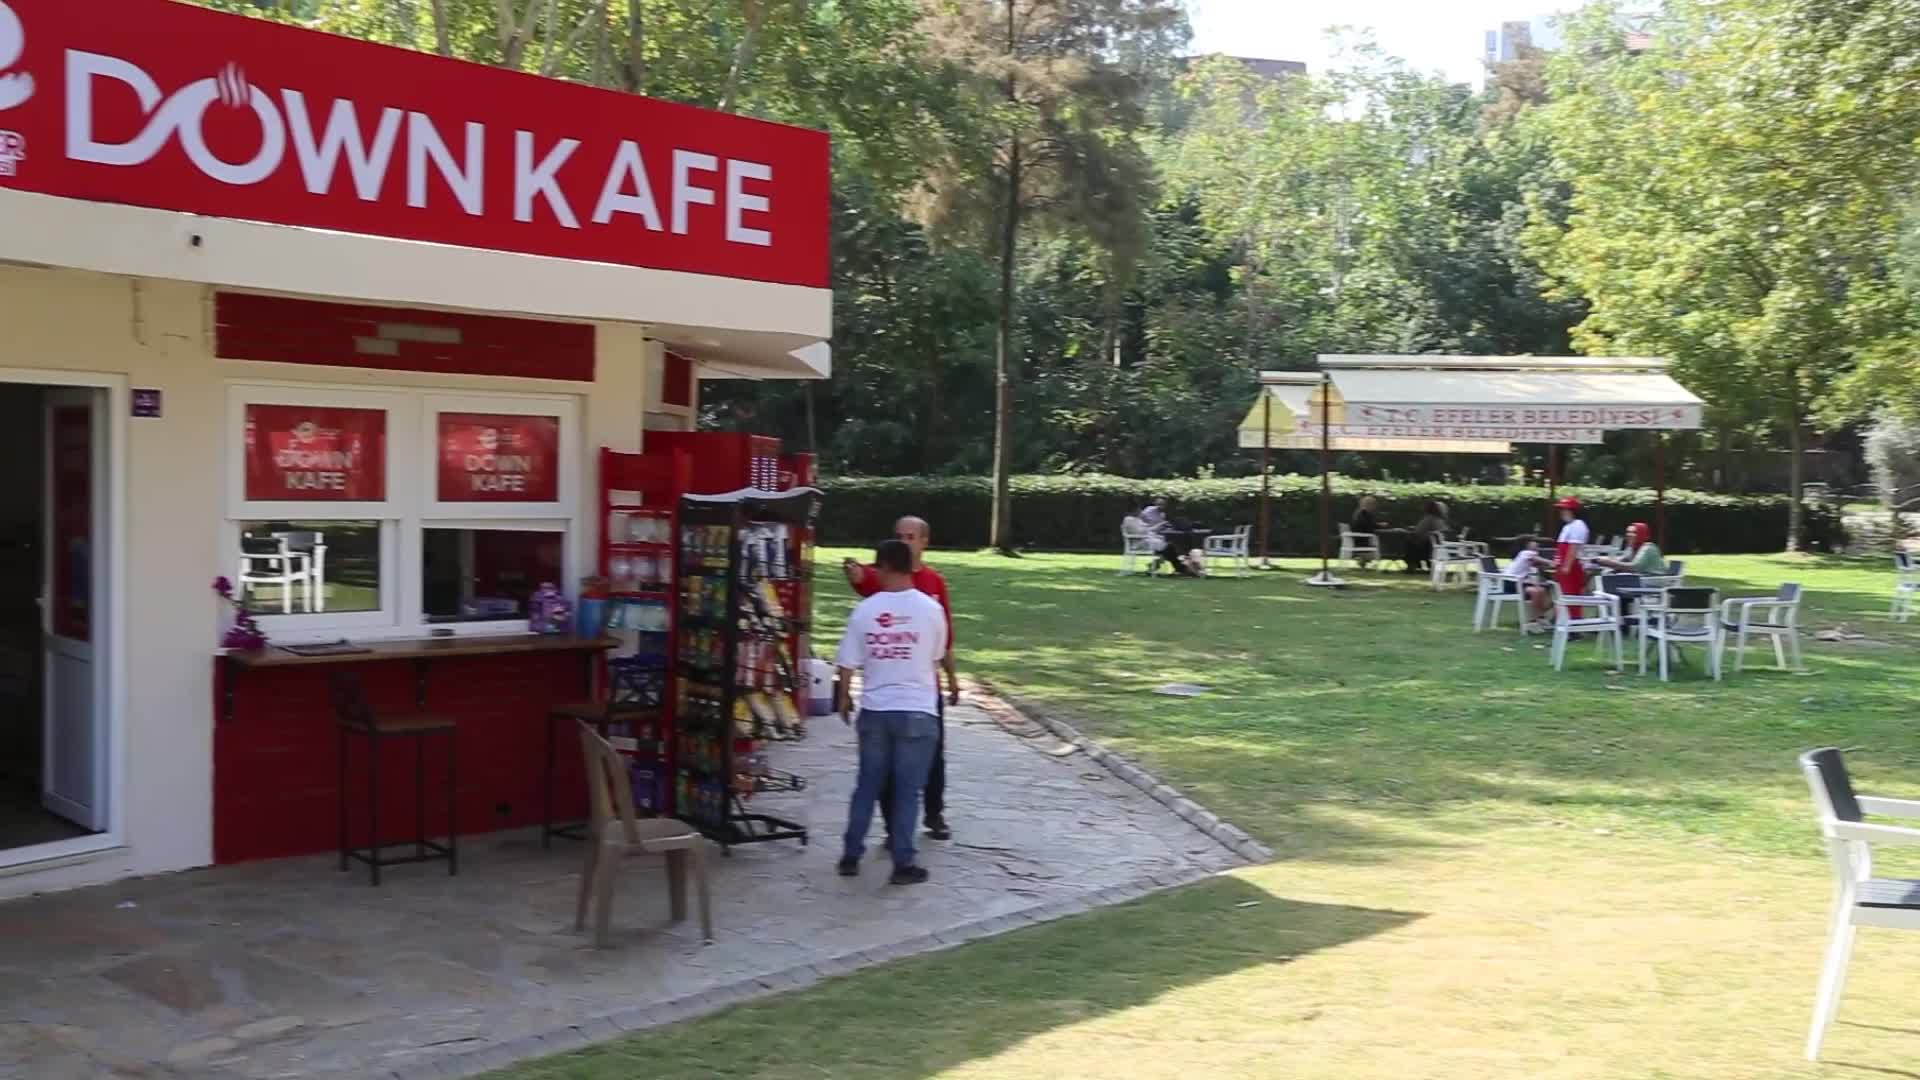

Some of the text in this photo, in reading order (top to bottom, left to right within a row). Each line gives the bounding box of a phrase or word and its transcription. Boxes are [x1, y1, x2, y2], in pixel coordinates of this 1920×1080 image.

[65, 48, 773, 248] DOWN KAFE
[1432, 407, 1517, 425] EFELER
[275, 448, 353, 469] DOWN
[464, 453, 531, 472] DOWN
[286, 471, 345, 490] KAFE
[471, 473, 526, 492] KAFE
[864, 631, 919, 646] DOWN
[869, 646, 912, 660] KAFE
